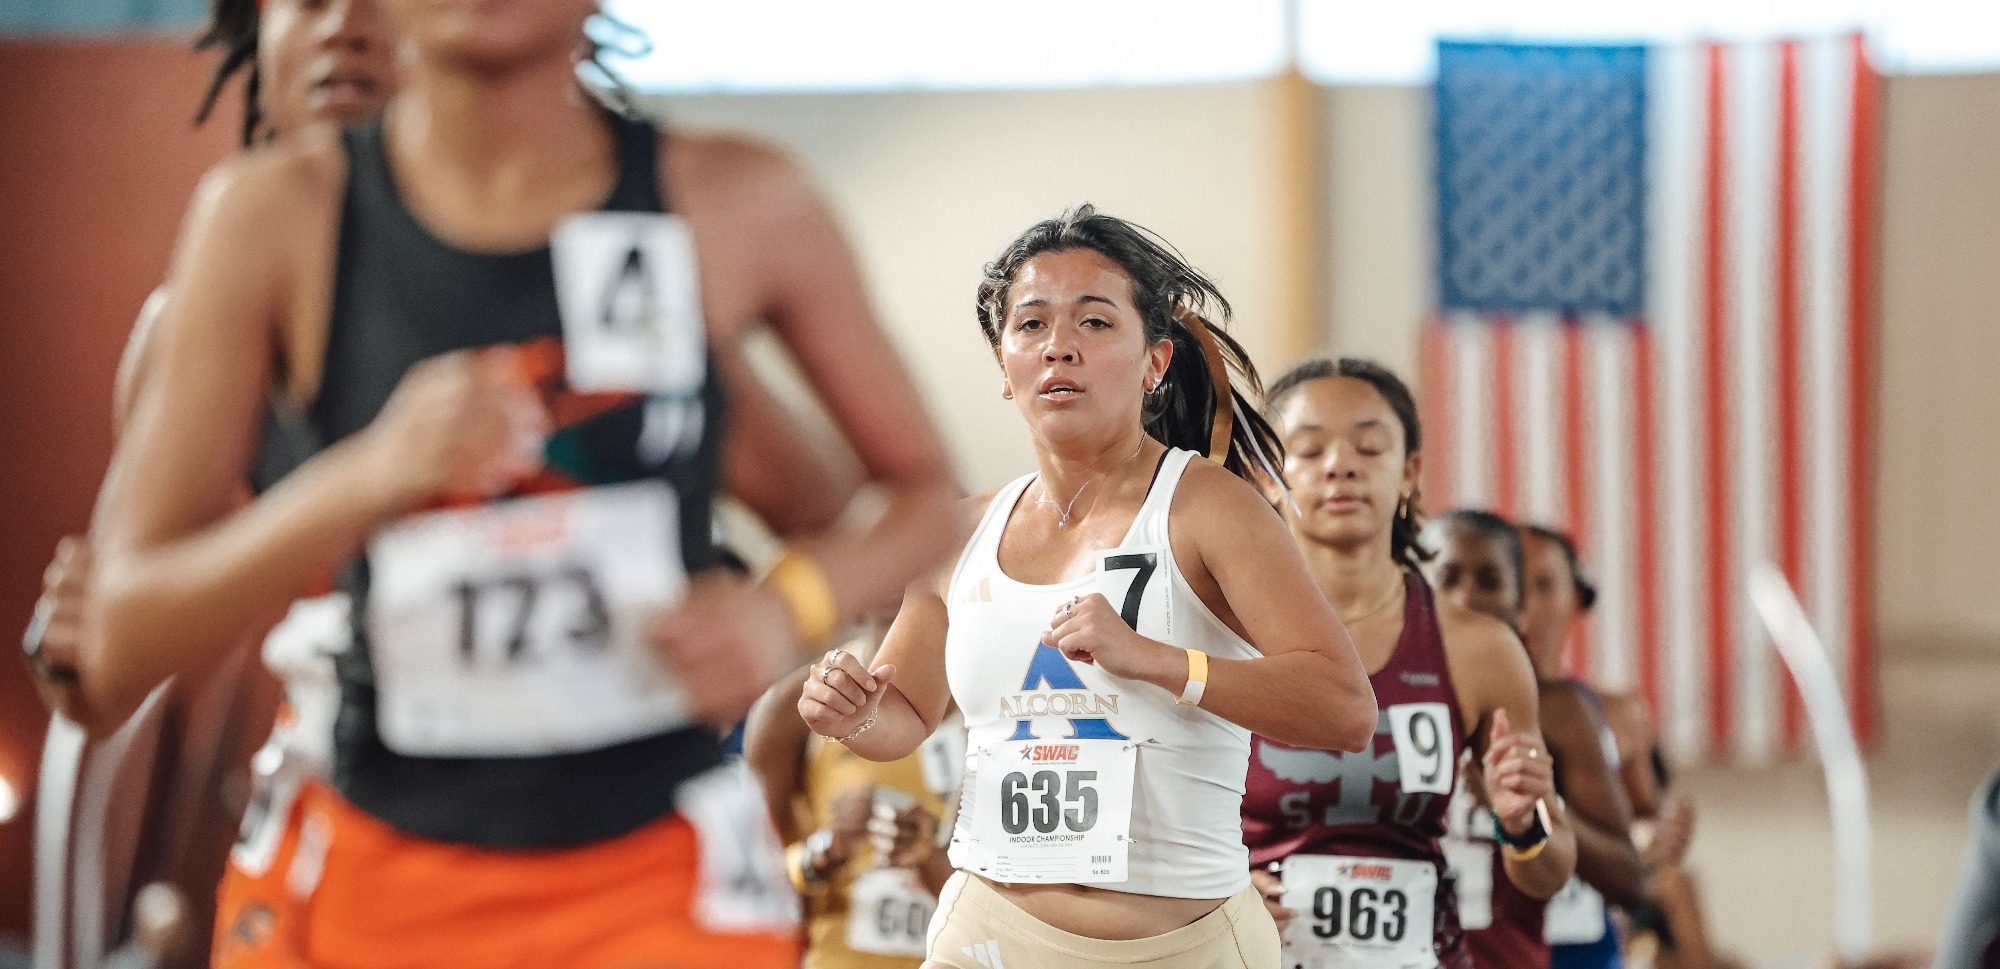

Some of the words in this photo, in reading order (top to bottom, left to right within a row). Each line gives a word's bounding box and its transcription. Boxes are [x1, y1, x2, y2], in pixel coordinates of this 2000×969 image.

[1104, 552, 1157, 632] 7
[999, 693, 1119, 718] ALCORN
[1032, 744, 1080, 761] SWAC
[1409, 711, 1441, 785] 9
[1001, 769, 1099, 835] 635
[1009, 836, 1035, 844] INDOOR
[1036, 834, 1085, 843] CHAMPIONSHIP
[1312, 886, 1407, 942] 963
